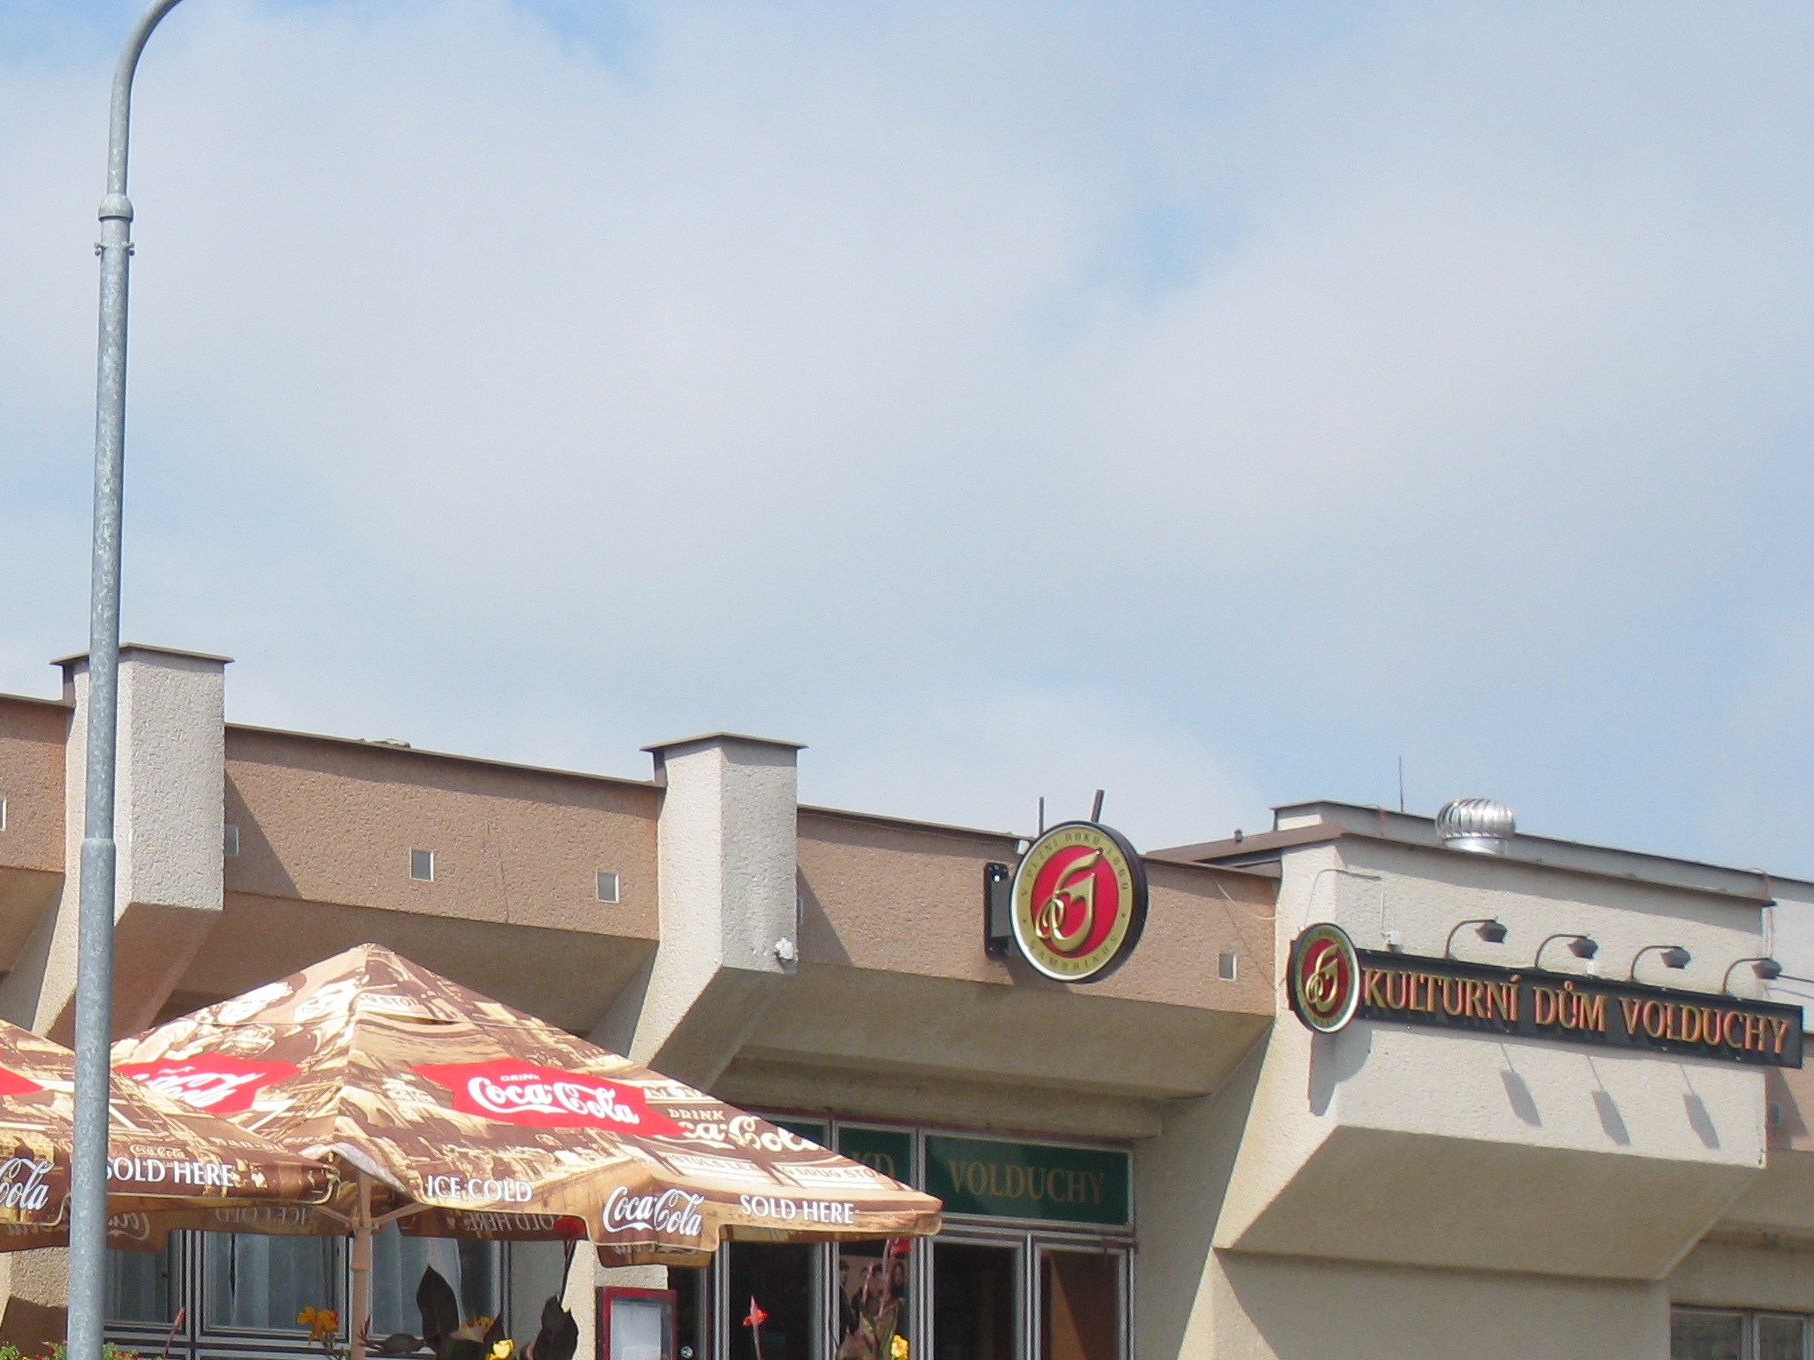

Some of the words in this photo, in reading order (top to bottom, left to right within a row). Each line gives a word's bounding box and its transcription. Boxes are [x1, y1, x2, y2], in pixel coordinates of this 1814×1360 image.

[1361, 967, 1520, 1023] KULTURNÍ
[1532, 980, 1607, 1033] DŮM
[1618, 996, 1790, 1055] VOLDUCHY
[467, 1076, 641, 1125] Coca-Cola
[173, 1161, 235, 1187] HERE
[426, 1174, 461, 1199] ICE
[466, 1177, 533, 1203] COLD
[946, 1159, 1105, 1205] VOLDUCHY
[601, 1184, 705, 1238] Coca-Cola
[740, 1193, 797, 1221] SOLD
[802, 1199, 855, 1225] HERE
